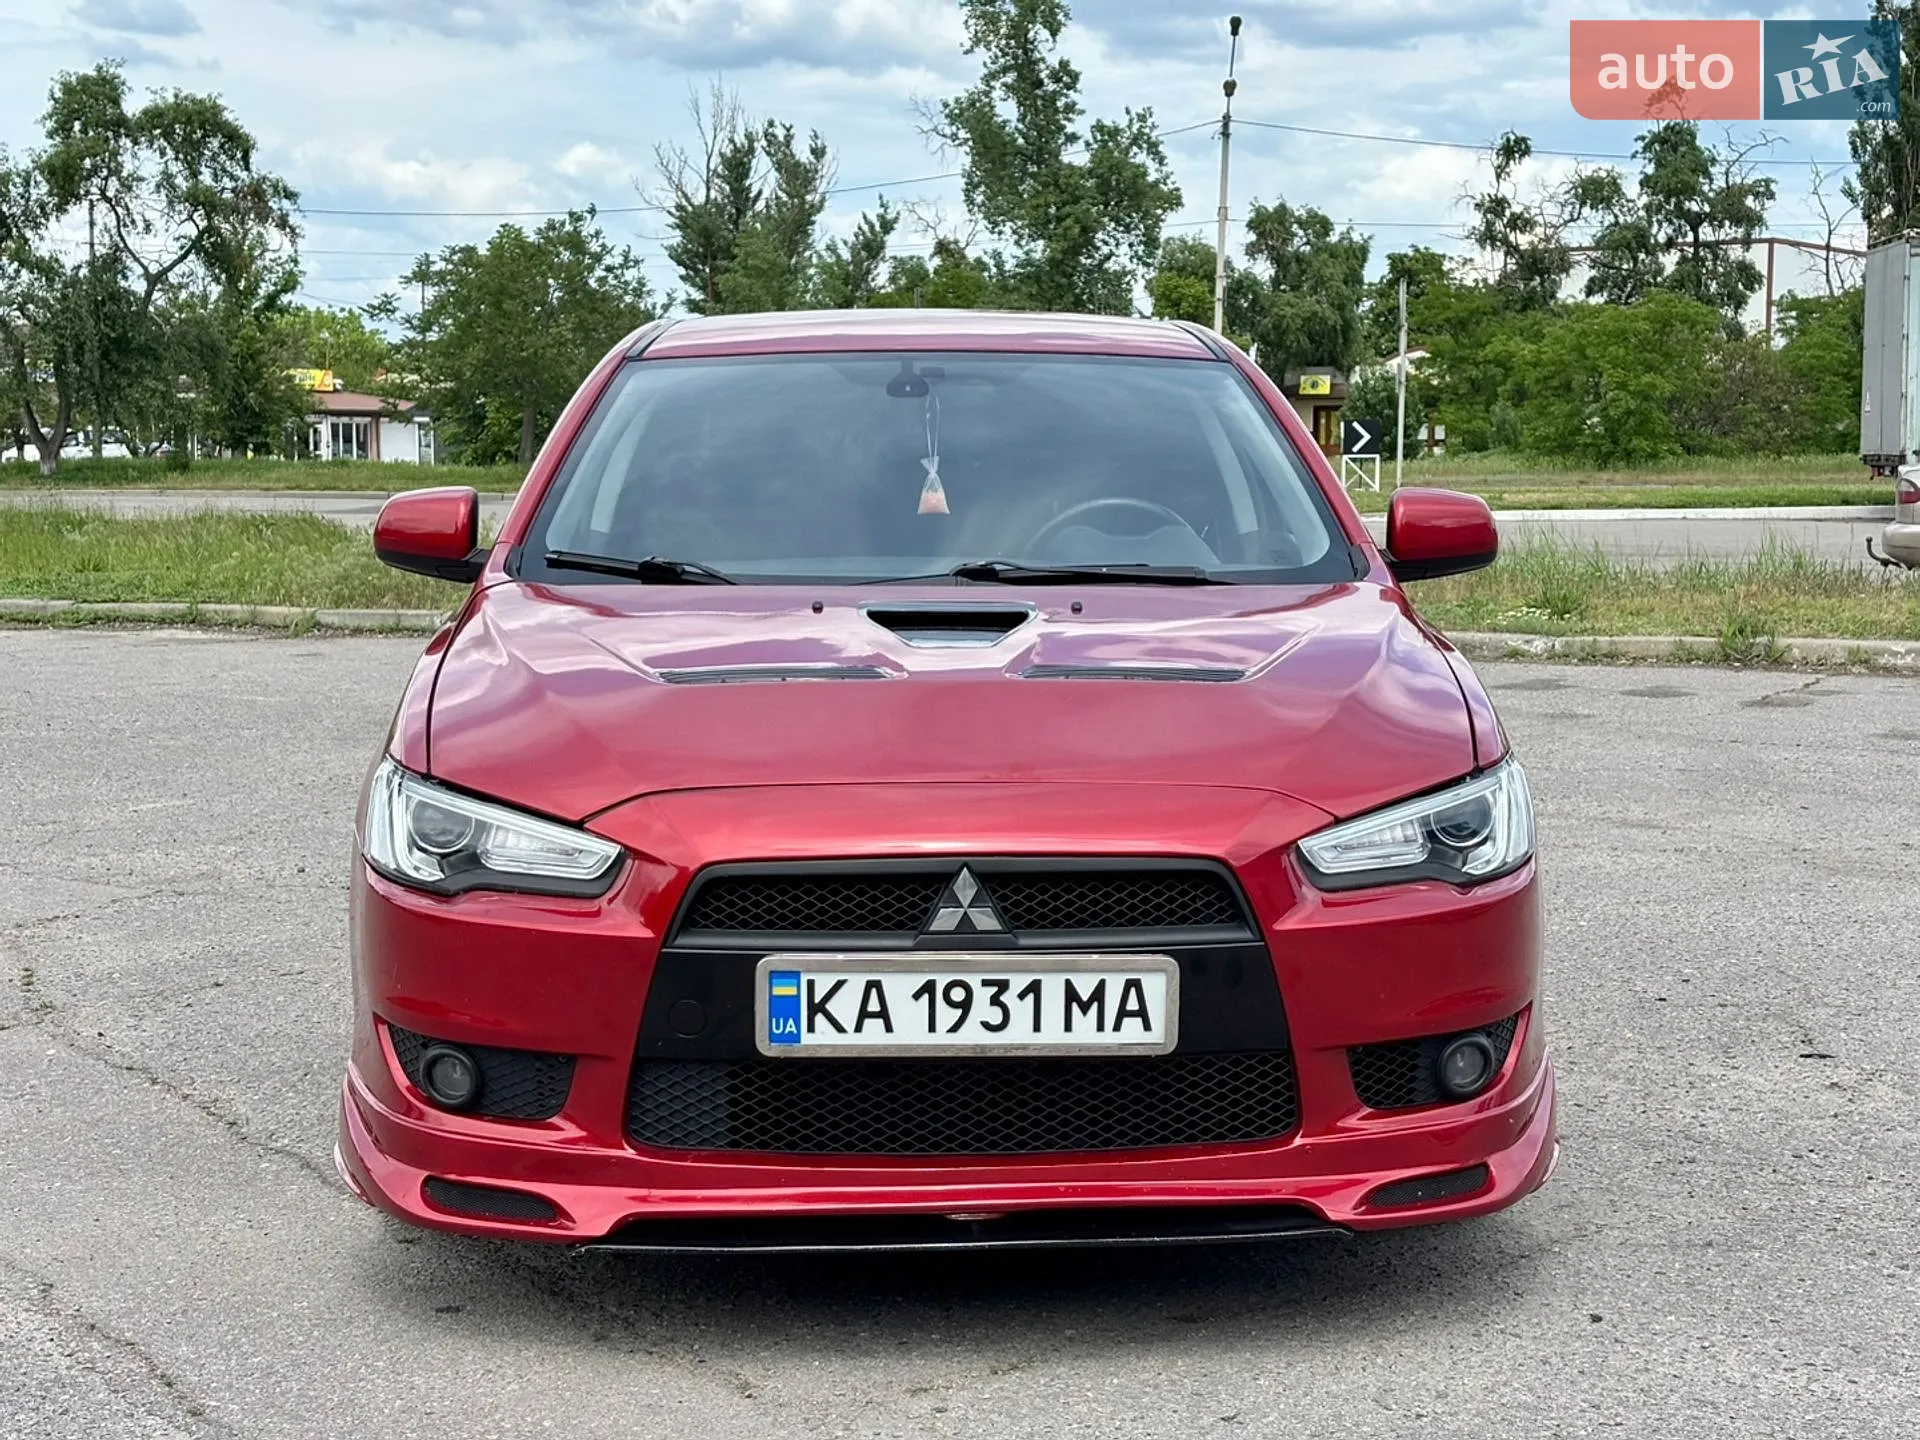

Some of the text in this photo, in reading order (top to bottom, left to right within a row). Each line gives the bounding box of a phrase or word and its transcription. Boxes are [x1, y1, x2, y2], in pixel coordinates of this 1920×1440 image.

[806, 978, 1153, 1033] KA 1931 MA
[772, 1017, 797, 1035] UA
